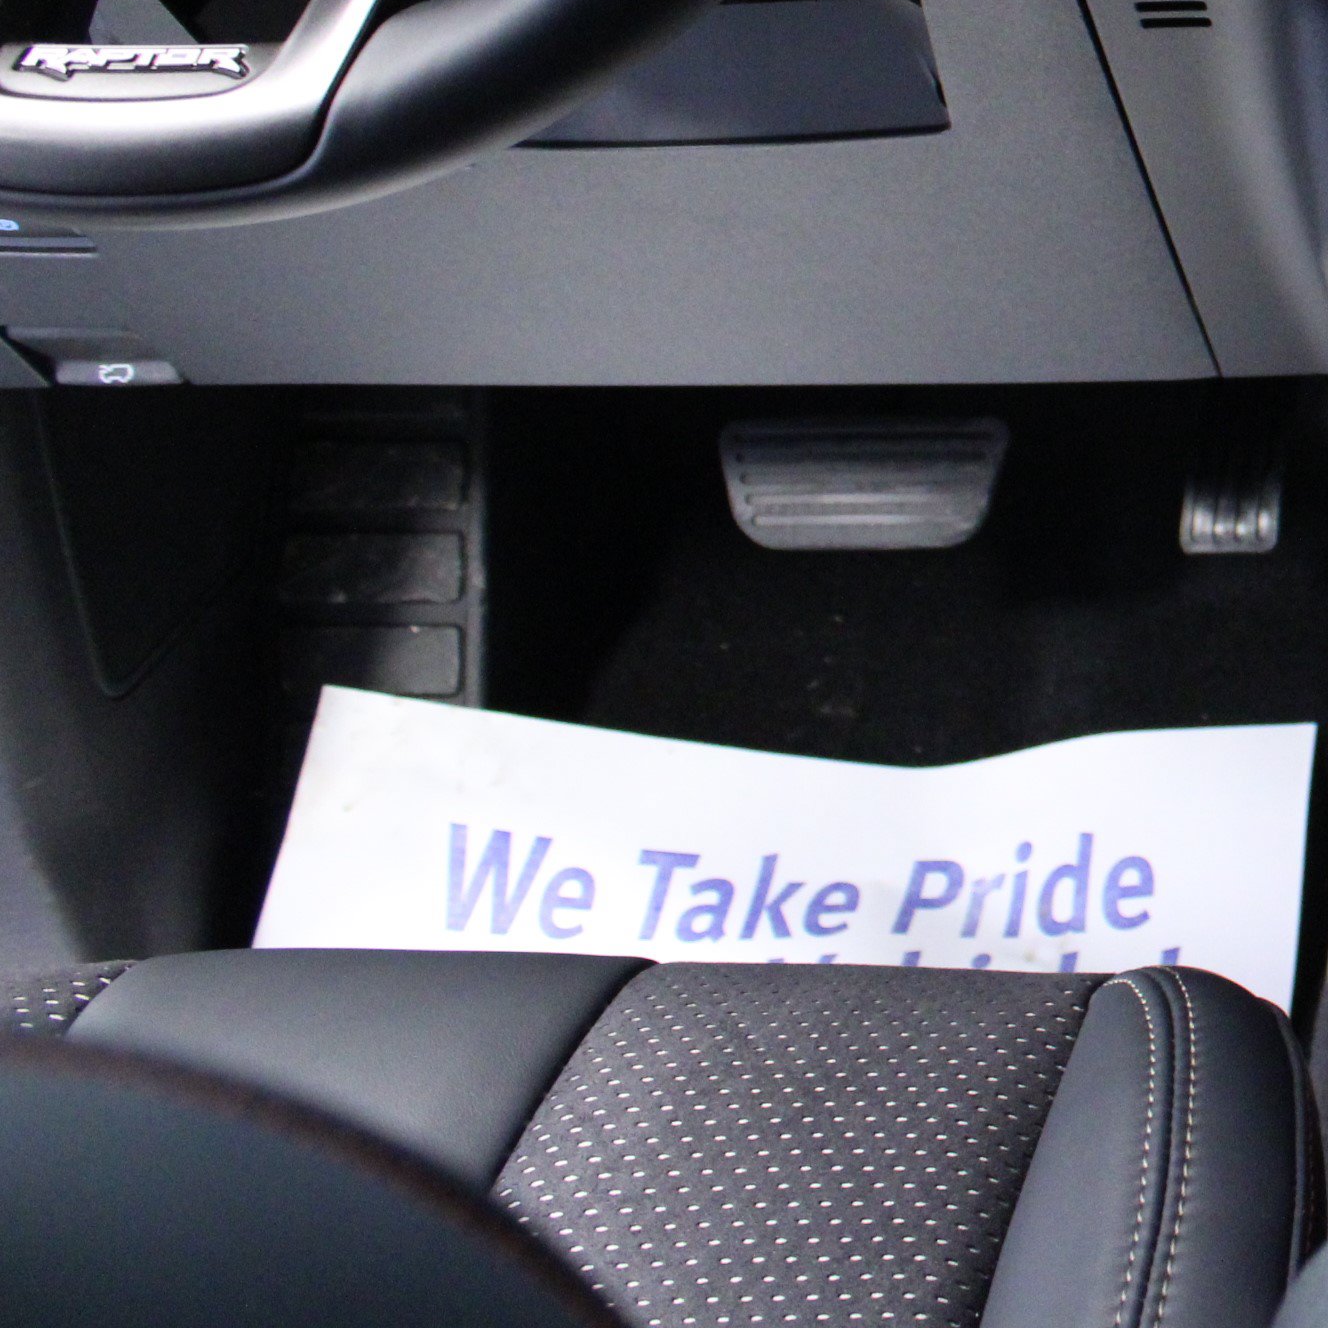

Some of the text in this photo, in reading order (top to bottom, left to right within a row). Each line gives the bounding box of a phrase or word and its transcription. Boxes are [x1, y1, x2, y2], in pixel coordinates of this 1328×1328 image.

[14, 45, 248, 78] RAPTOR
[444, 822, 1158, 943] We Take Pride
